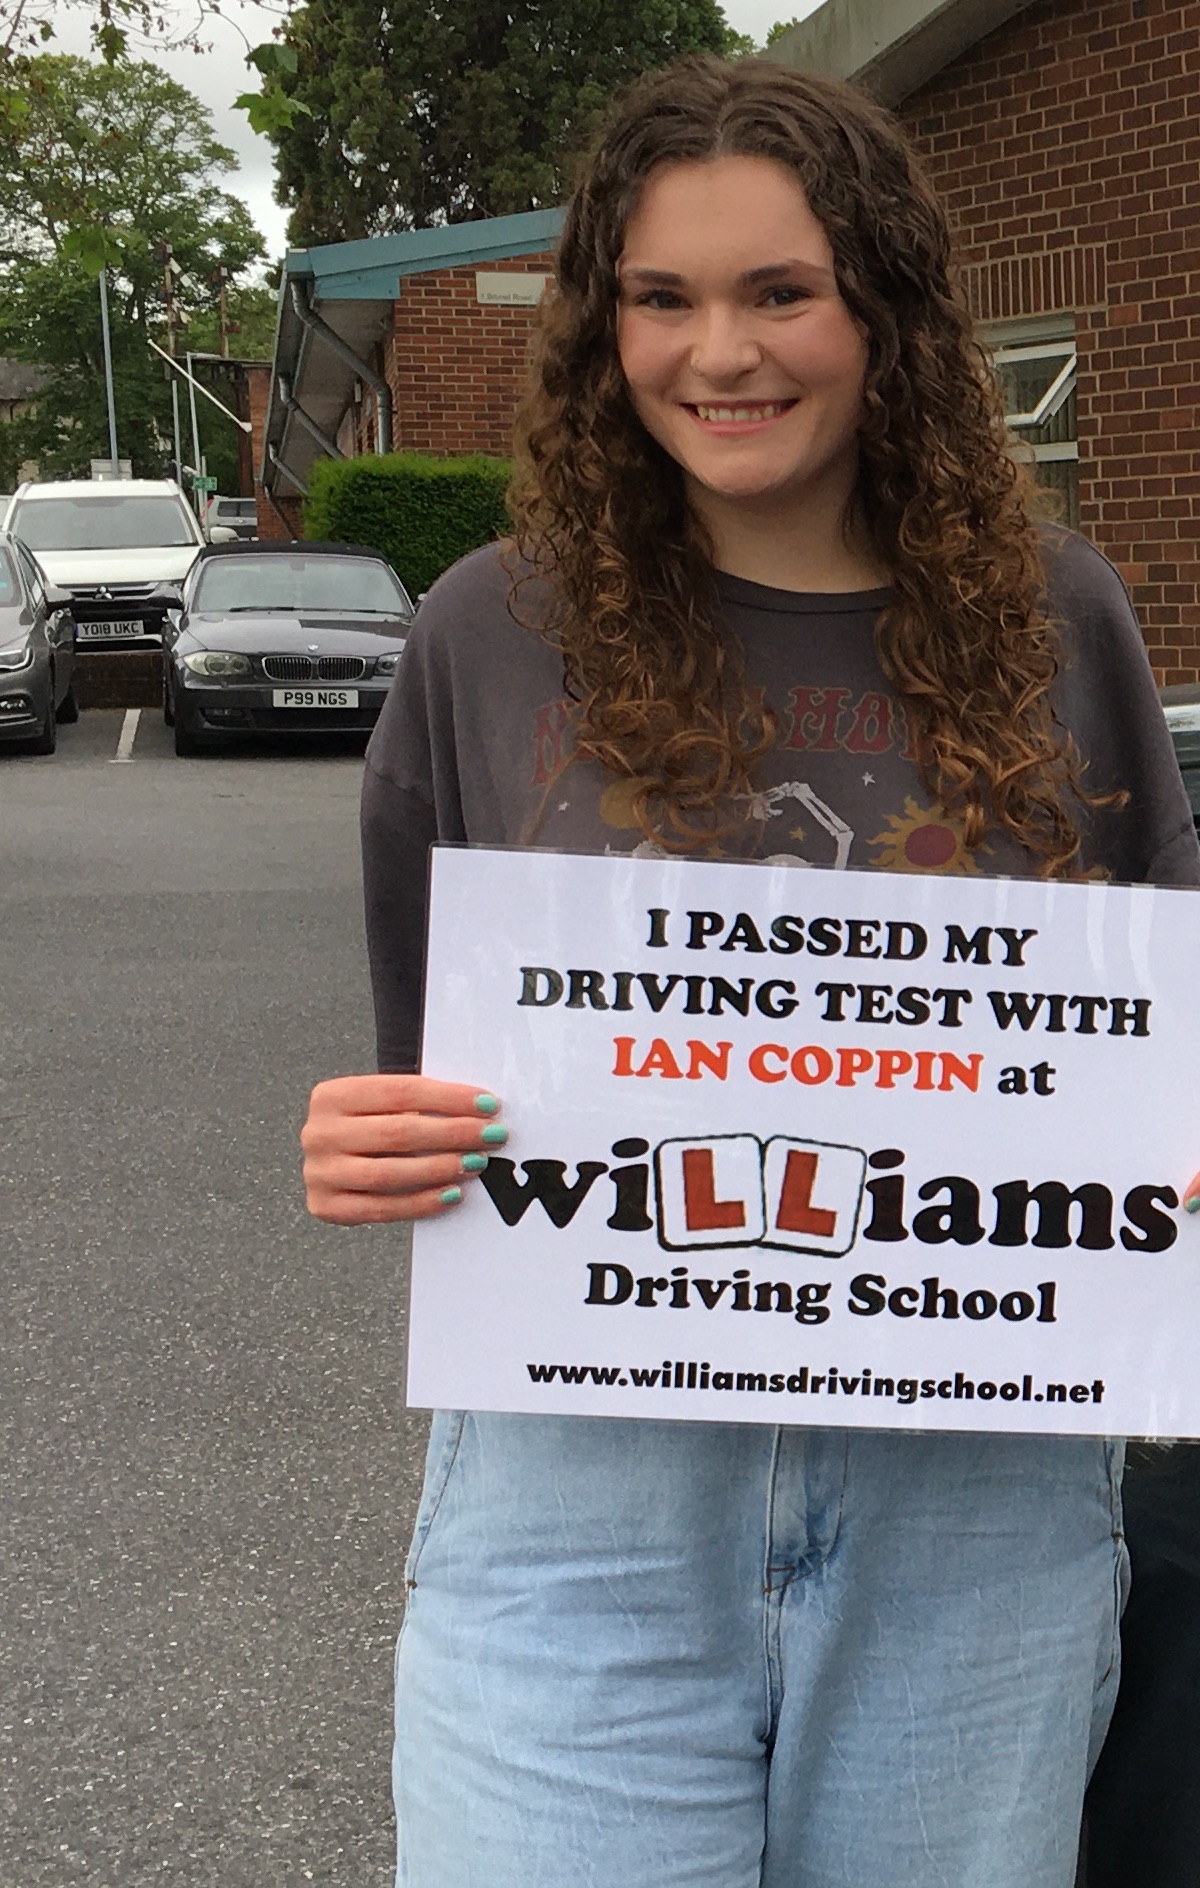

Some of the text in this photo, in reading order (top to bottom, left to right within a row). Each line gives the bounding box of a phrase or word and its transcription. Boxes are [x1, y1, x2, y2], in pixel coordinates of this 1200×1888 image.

[82, 622, 140, 636] YO18 UKC
[284, 691, 348, 706] P99 NGS
[646, 908, 1038, 967] I PASSED MY
[516, 966, 1152, 1037] DRIVING TEST WITH
[612, 1037, 1056, 1096] IAN COPPIN at
[583, 1263, 1058, 1326] Driving School
[526, 1360, 1105, 1405] www.williamsdrivingschool.net
